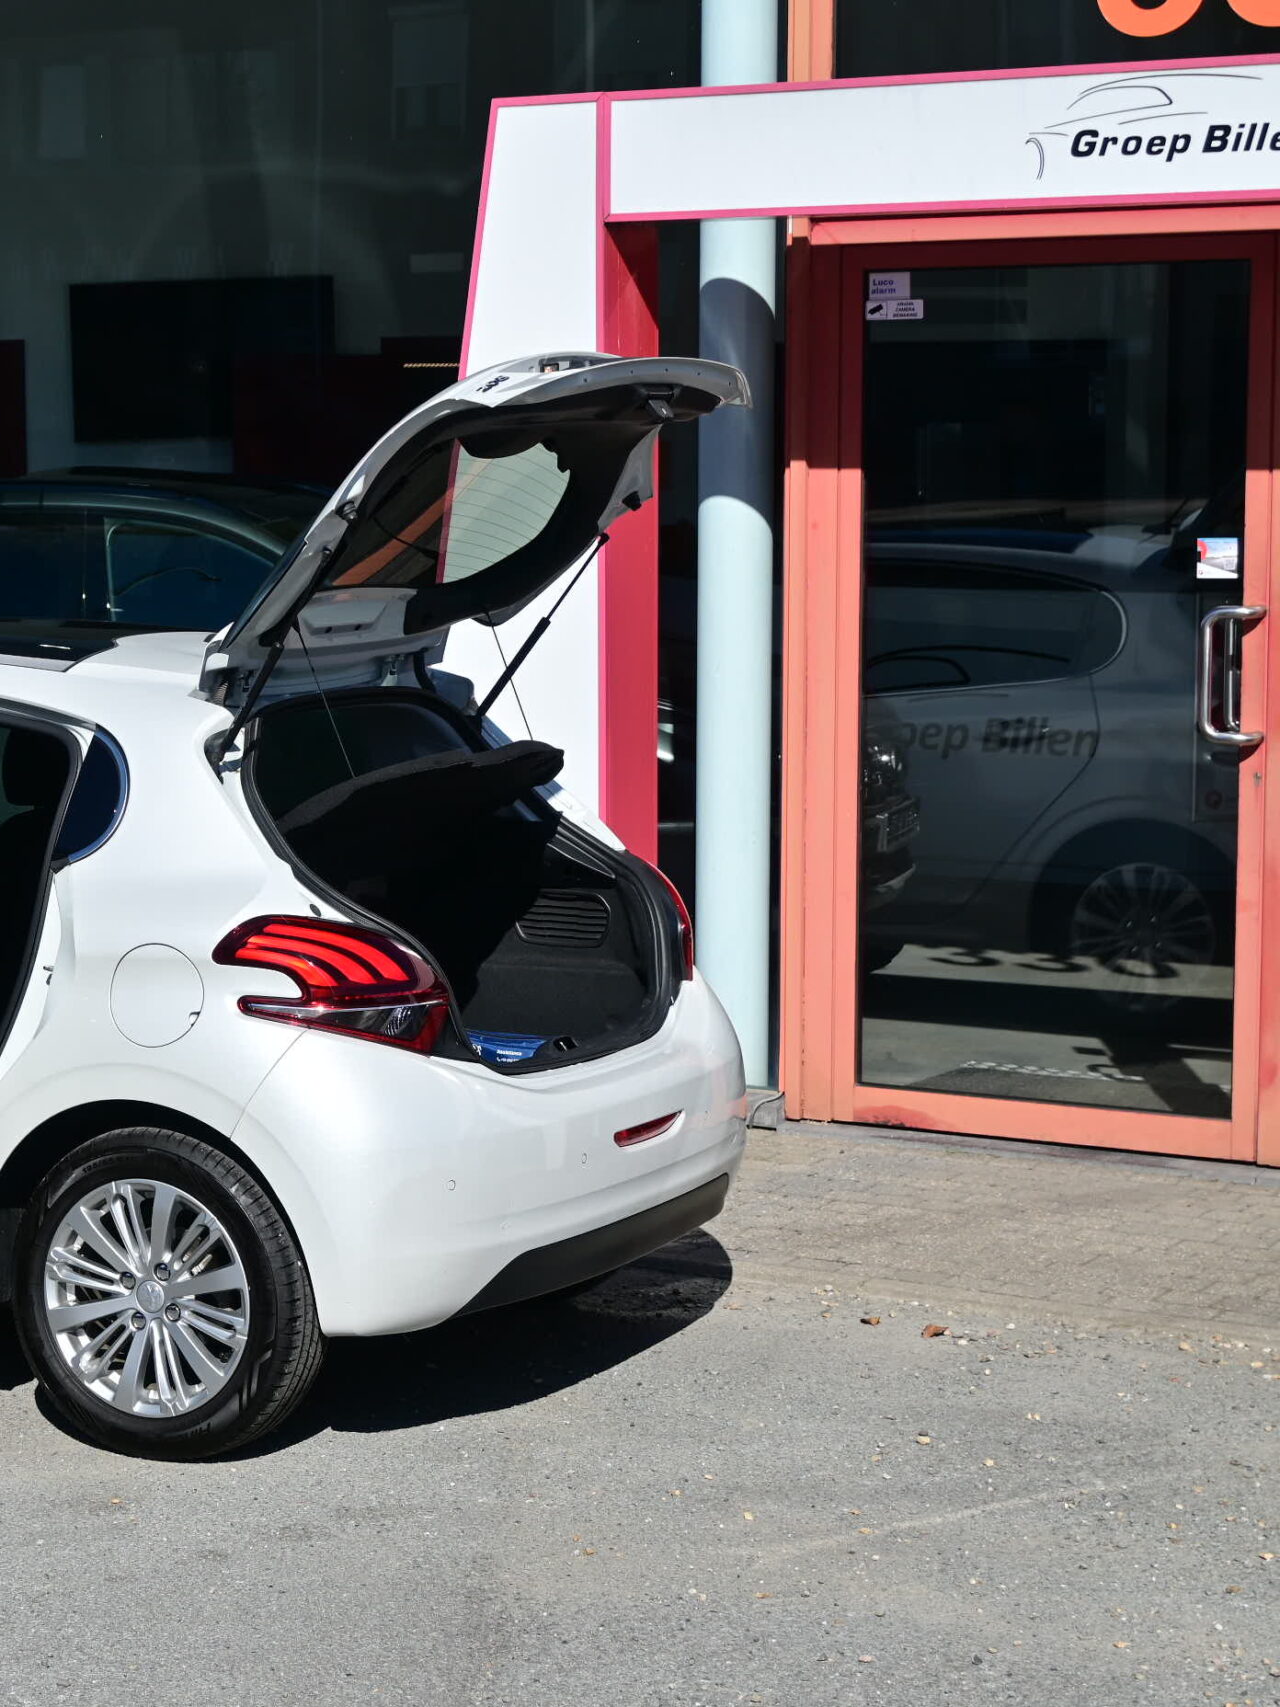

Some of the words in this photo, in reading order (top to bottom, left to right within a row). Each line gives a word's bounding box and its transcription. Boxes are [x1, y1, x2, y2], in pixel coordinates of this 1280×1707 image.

[1071, 129, 1192, 162] Groep
[871, 286, 896, 295] alarm
[980, 716, 1097, 757] Billen
